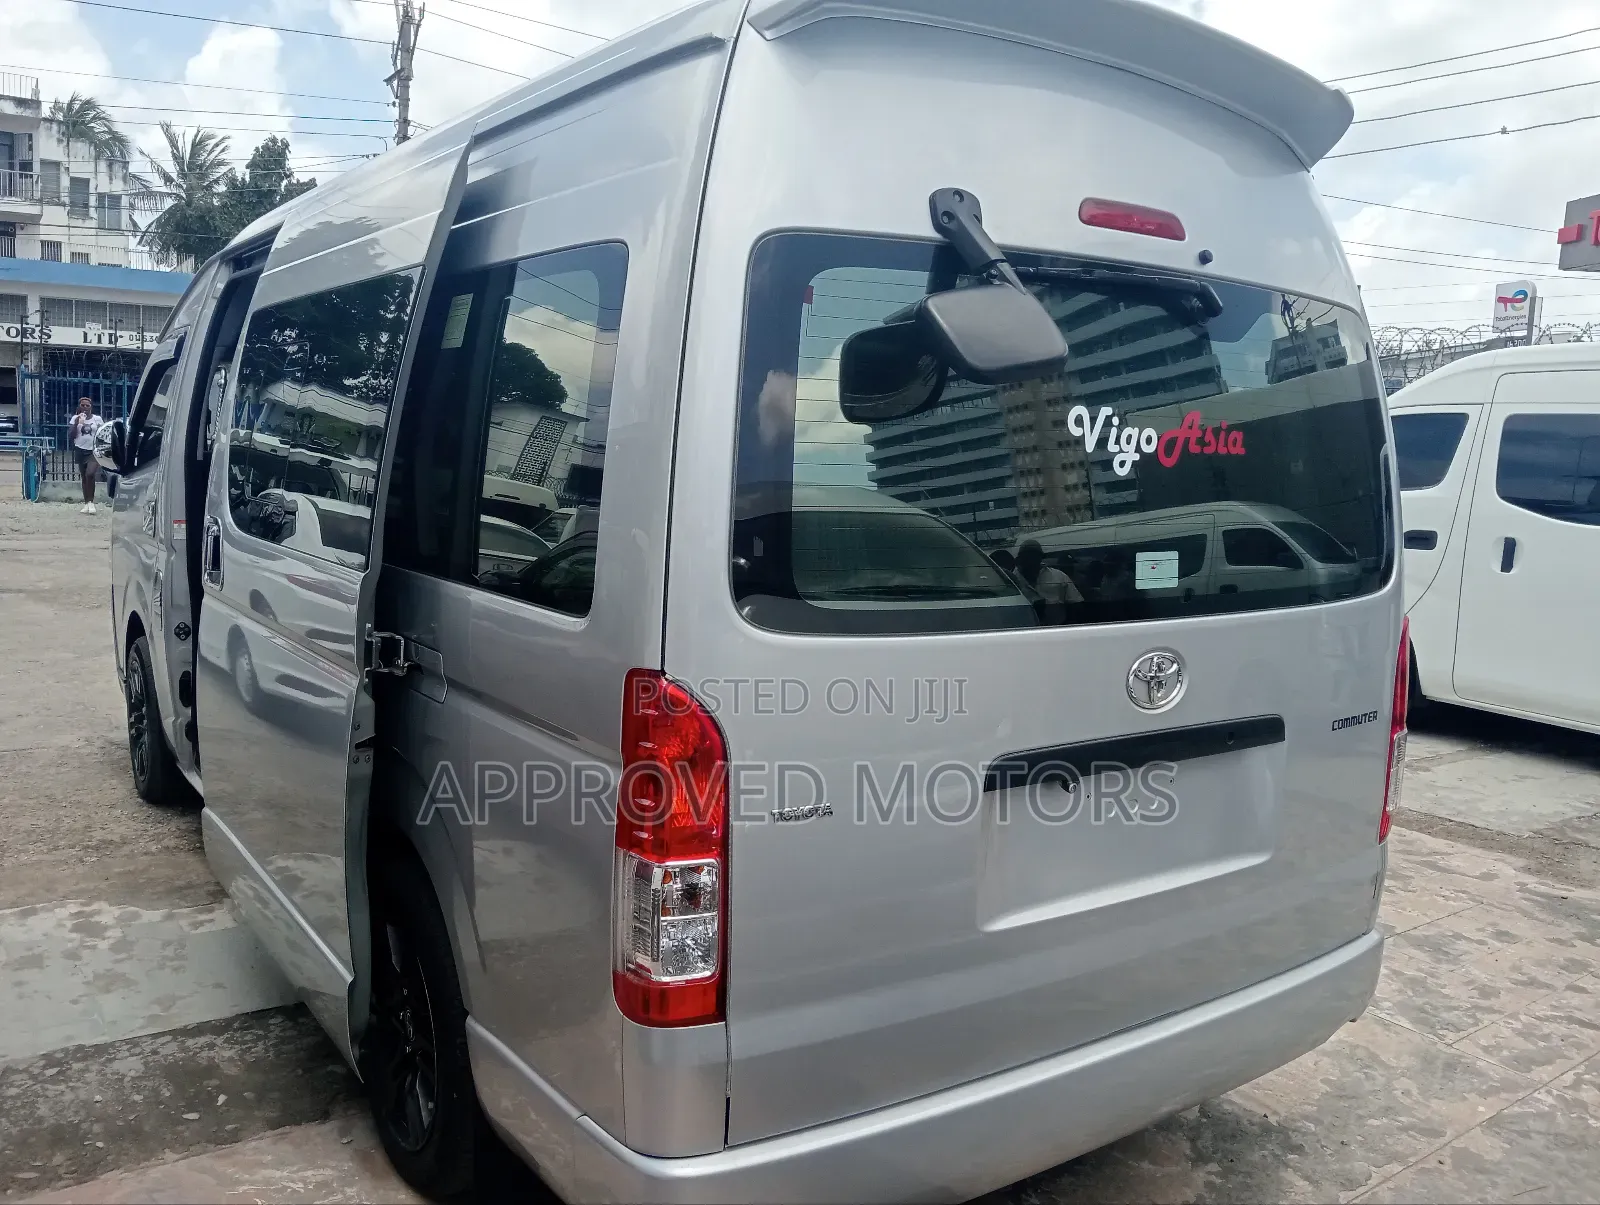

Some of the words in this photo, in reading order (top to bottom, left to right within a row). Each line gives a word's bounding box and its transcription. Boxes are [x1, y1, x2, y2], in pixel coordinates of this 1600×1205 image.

[0, 325, 52, 340] ORS
[1331, 710, 1378, 731] COMMUTER
[771, 803, 834, 823] TOYOTA
